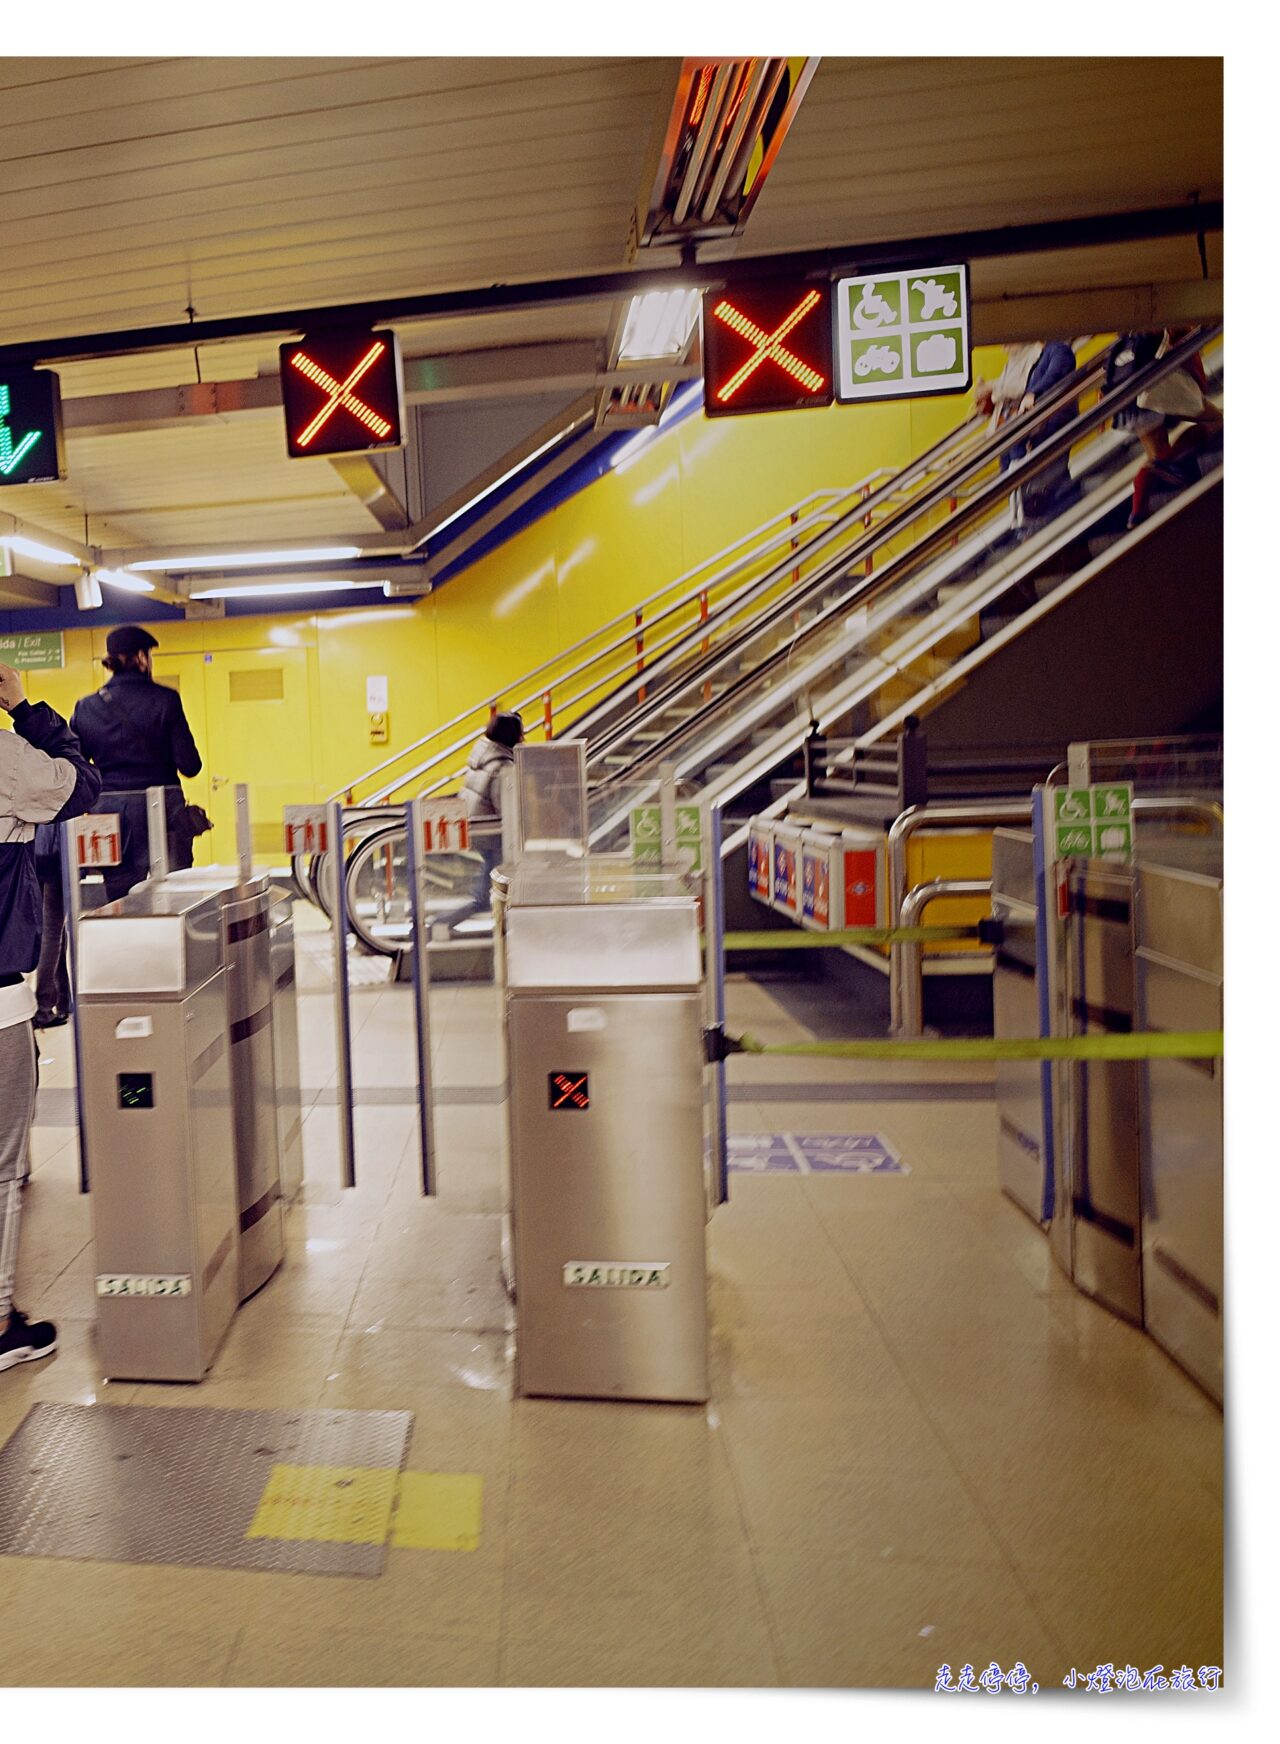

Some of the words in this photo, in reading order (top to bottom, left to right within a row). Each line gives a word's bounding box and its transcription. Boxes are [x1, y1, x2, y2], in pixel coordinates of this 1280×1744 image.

[24, 637, 41, 648] Exit
[571, 1267, 662, 1286] SALIDA
[104, 1278, 183, 1295] SALIDA
